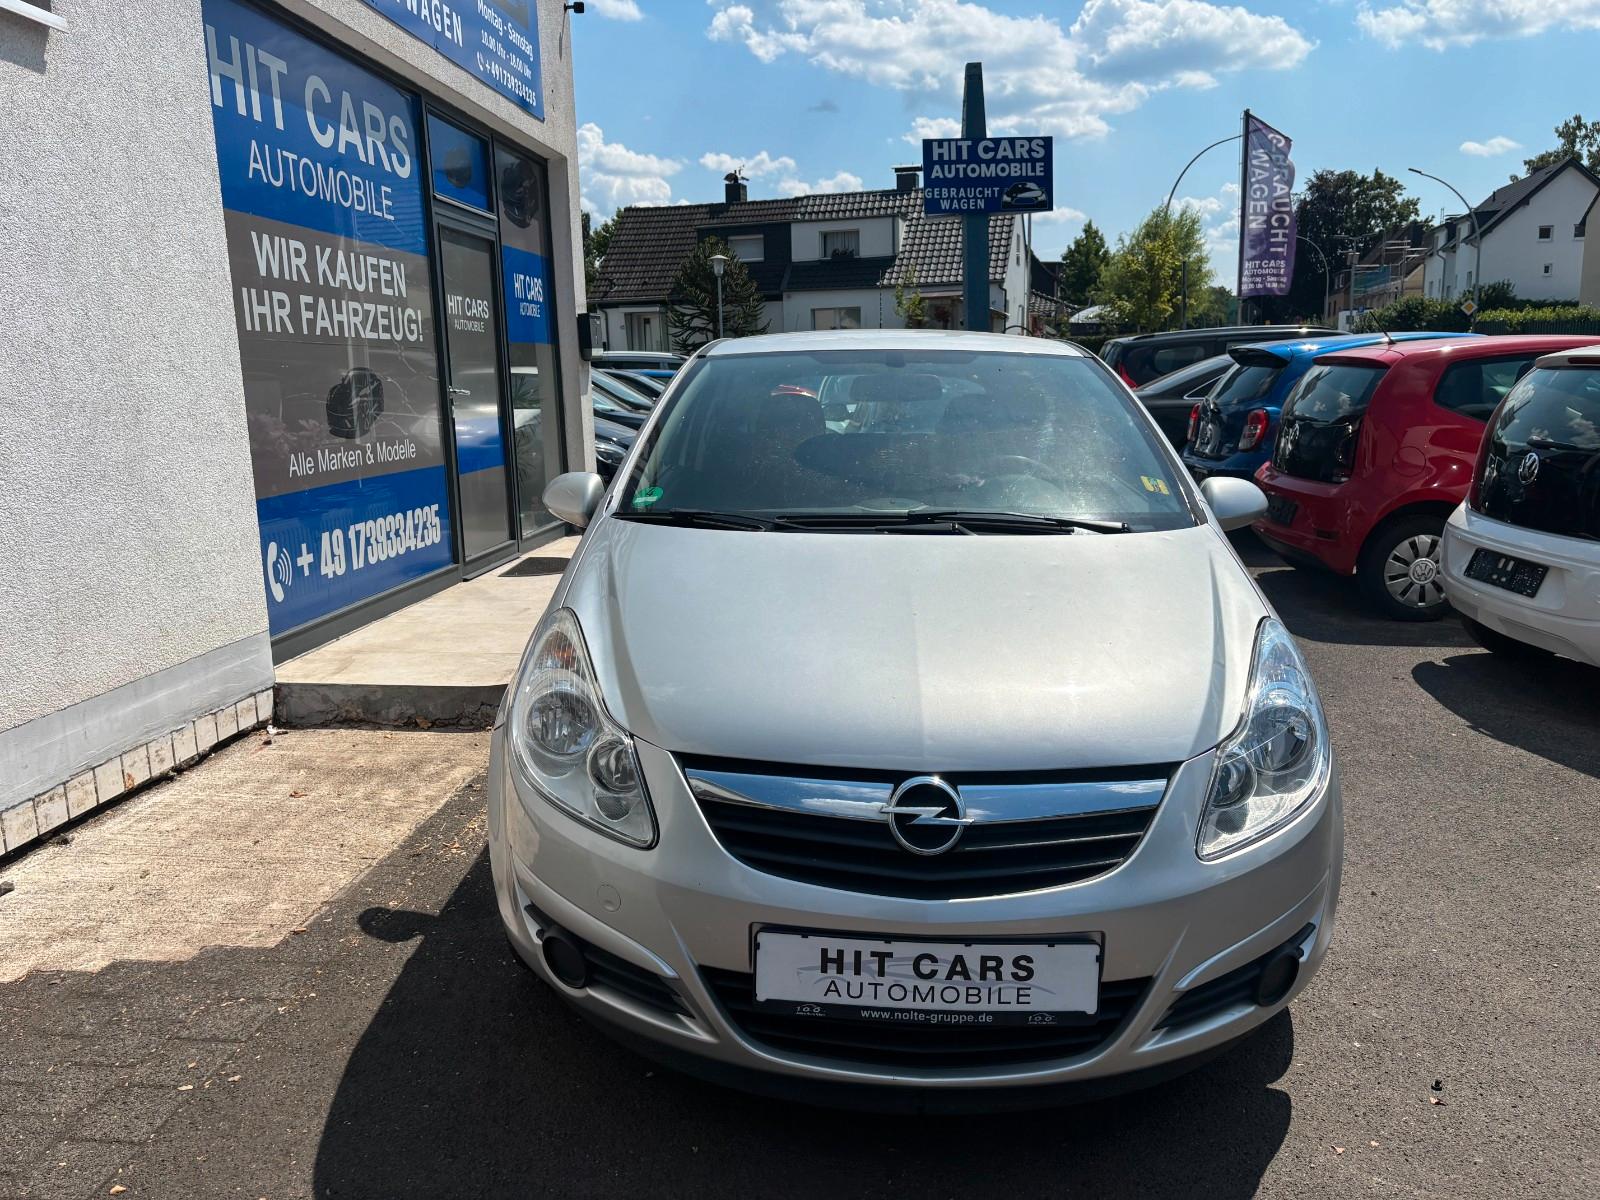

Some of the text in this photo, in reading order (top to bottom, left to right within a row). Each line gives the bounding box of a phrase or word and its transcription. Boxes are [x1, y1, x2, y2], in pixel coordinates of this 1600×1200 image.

[478, 0, 503, 36] Montag
[507, 22, 533, 62] Samstag
[206, 25, 411, 178] HIT CARS
[932, 139, 1045, 161] HIT CARS
[249, 140, 395, 221] AUTOMOBILE
[931, 162, 1045, 179] AUTOMOBILE
[925, 187, 1000, 199] GEBRAUCHT
[1248, 149, 1270, 229] WAGEN
[940, 199, 985, 210] WAGEN
[251, 231, 407, 298] WIR KAUFEN
[1245, 260, 1261, 269] HIT
[513, 272, 543, 303] HIT CARS
[242, 287, 423, 341] IHR FAHRZEUG!
[447, 294, 489, 319] HIT CARS
[520, 302, 541, 318] AUTOMOBILE
[454, 319, 485, 333] AUTOMOBILE
[289, 439, 416, 478] Alle Marken & Modelle
[320, 528, 346, 579] 49
[349, 504, 441, 571] 1739334235
[819, 947, 1035, 982] HIT CARS
[823, 980, 1032, 1005] AUTOMOBILE
[861, 1008, 993, 1024] www.nolte-gruppe.de
